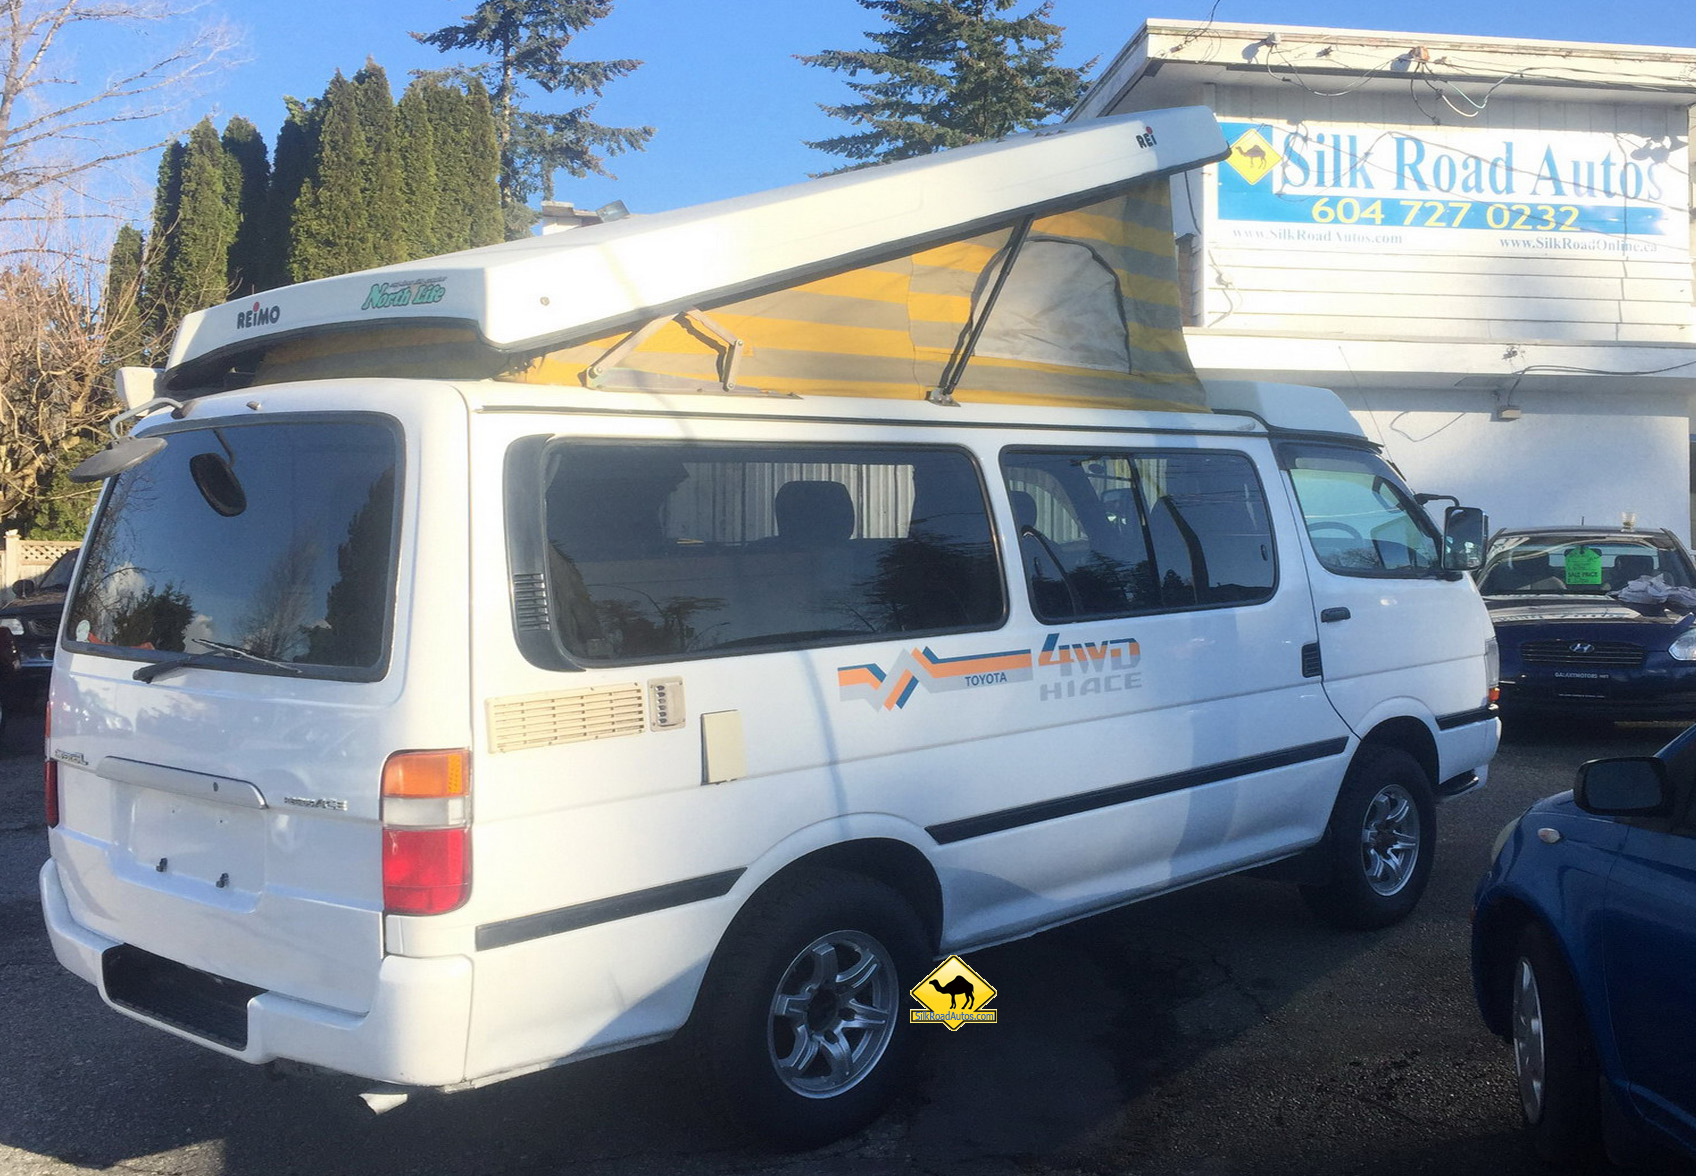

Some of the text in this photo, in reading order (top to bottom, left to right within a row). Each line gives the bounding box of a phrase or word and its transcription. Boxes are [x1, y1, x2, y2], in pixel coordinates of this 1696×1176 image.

[1280, 131, 1665, 201] Silk Road Autos
[1311, 198, 1581, 231] 604 727 0232
[361, 282, 411, 310] North
[411, 284, 446, 304] Life
[1038, 633, 1141, 677] 4WD
[964, 672, 1007, 687] TOYOTA
[1040, 671, 1142, 701] HIACE
